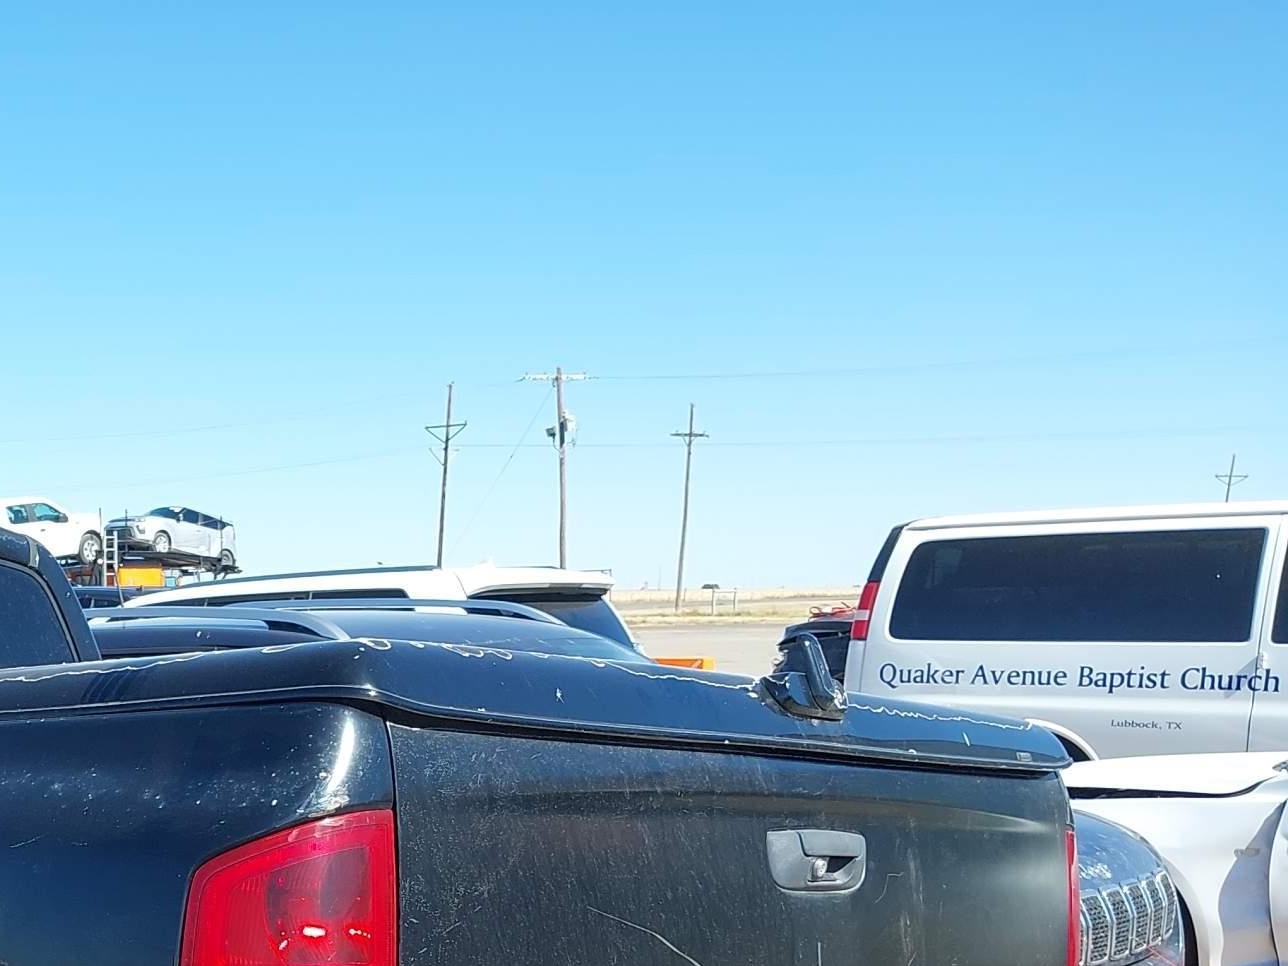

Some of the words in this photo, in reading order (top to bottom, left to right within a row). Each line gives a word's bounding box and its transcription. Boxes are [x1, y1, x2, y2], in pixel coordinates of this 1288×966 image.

[878, 662, 966, 688] Quaker
[970, 664, 1068, 687] Avenue
[1077, 665, 1171, 694] Baptist
[1180, 666, 1280, 693] Church
[1110, 719, 1163, 731] Lubbock,
[1166, 721, 1183, 731] TX
